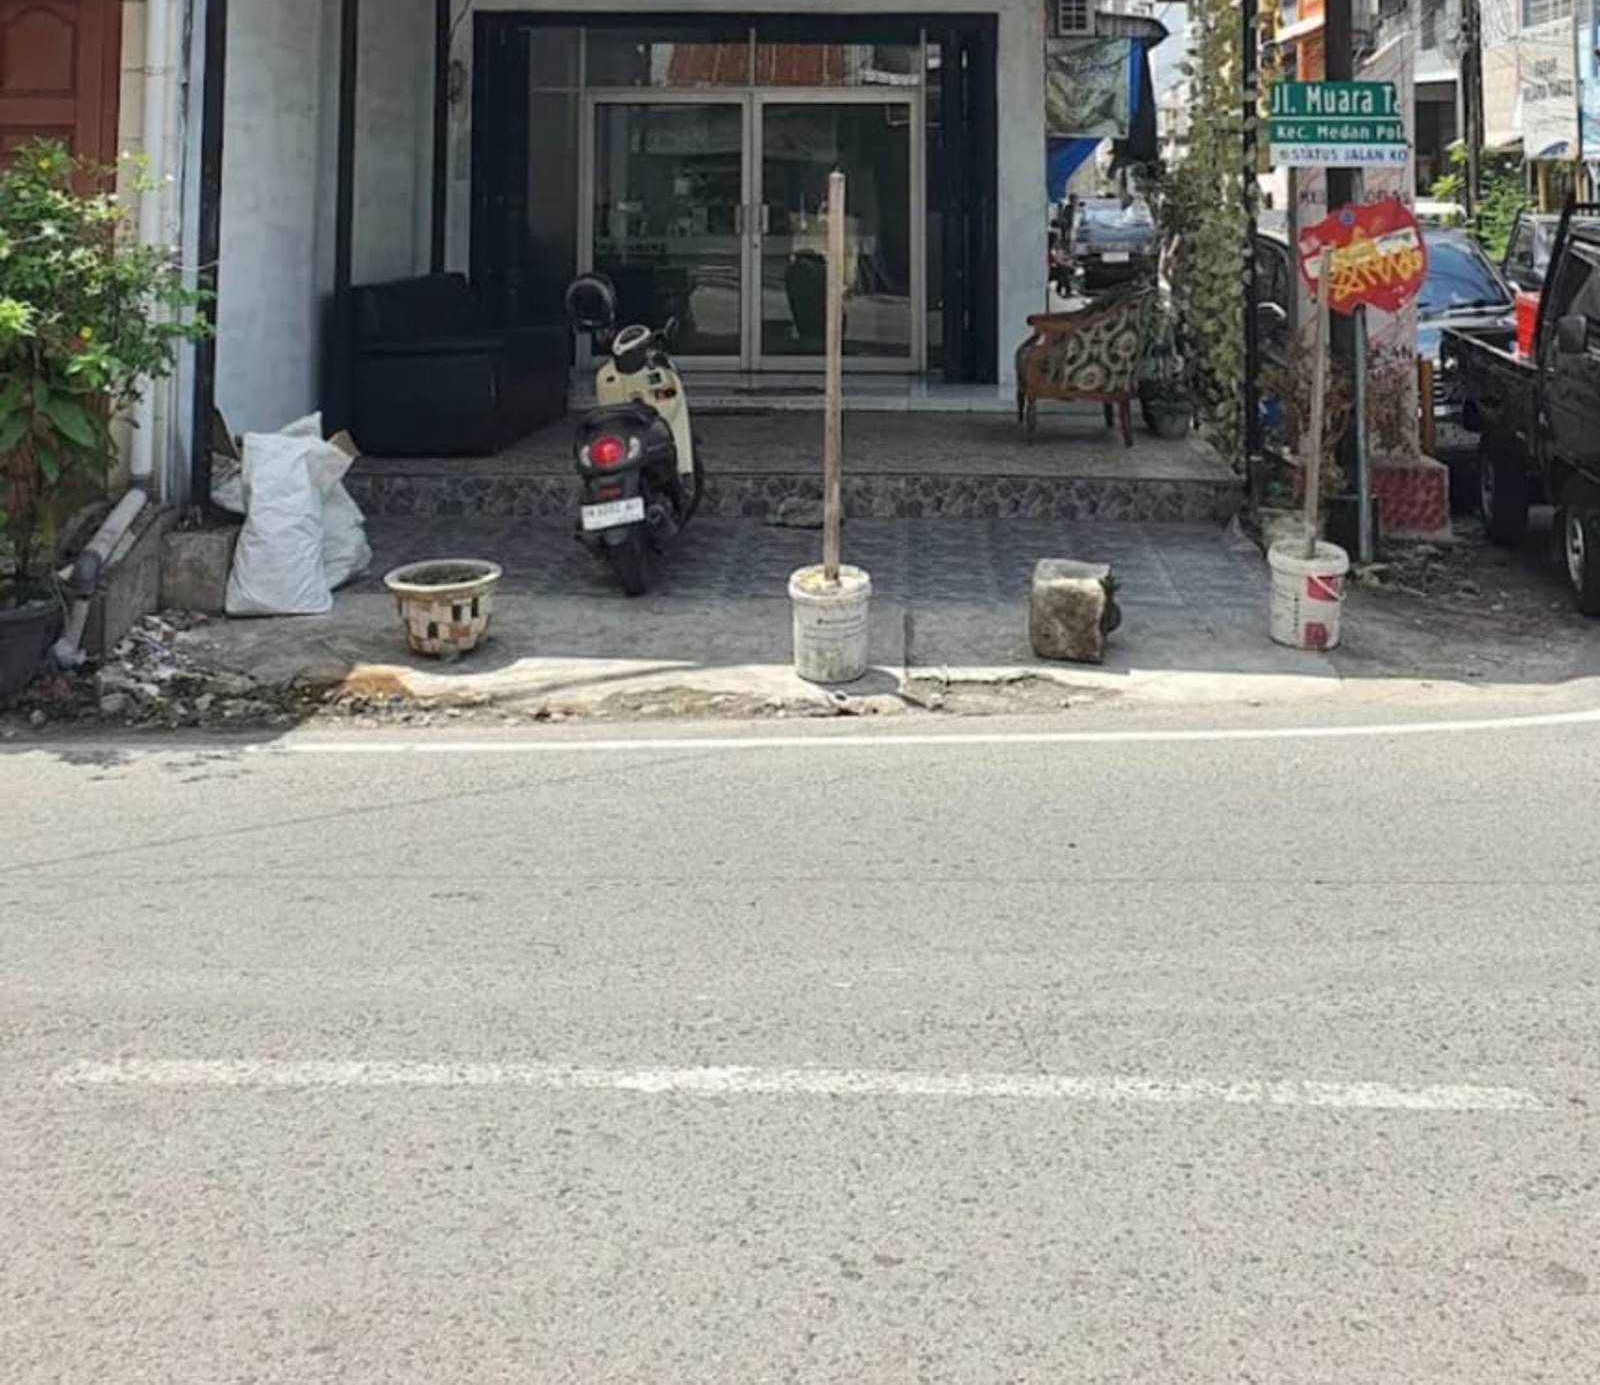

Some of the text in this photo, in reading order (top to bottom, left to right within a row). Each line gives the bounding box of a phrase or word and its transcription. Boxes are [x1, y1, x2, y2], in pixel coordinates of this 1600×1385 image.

[1271, 83, 1297, 114] Jl.
[1305, 84, 1374, 114] Muara
[1316, 123, 1371, 141] Medan
[1290, 147, 1339, 163] STATUS
[1344, 147, 1384, 162] JALAN
